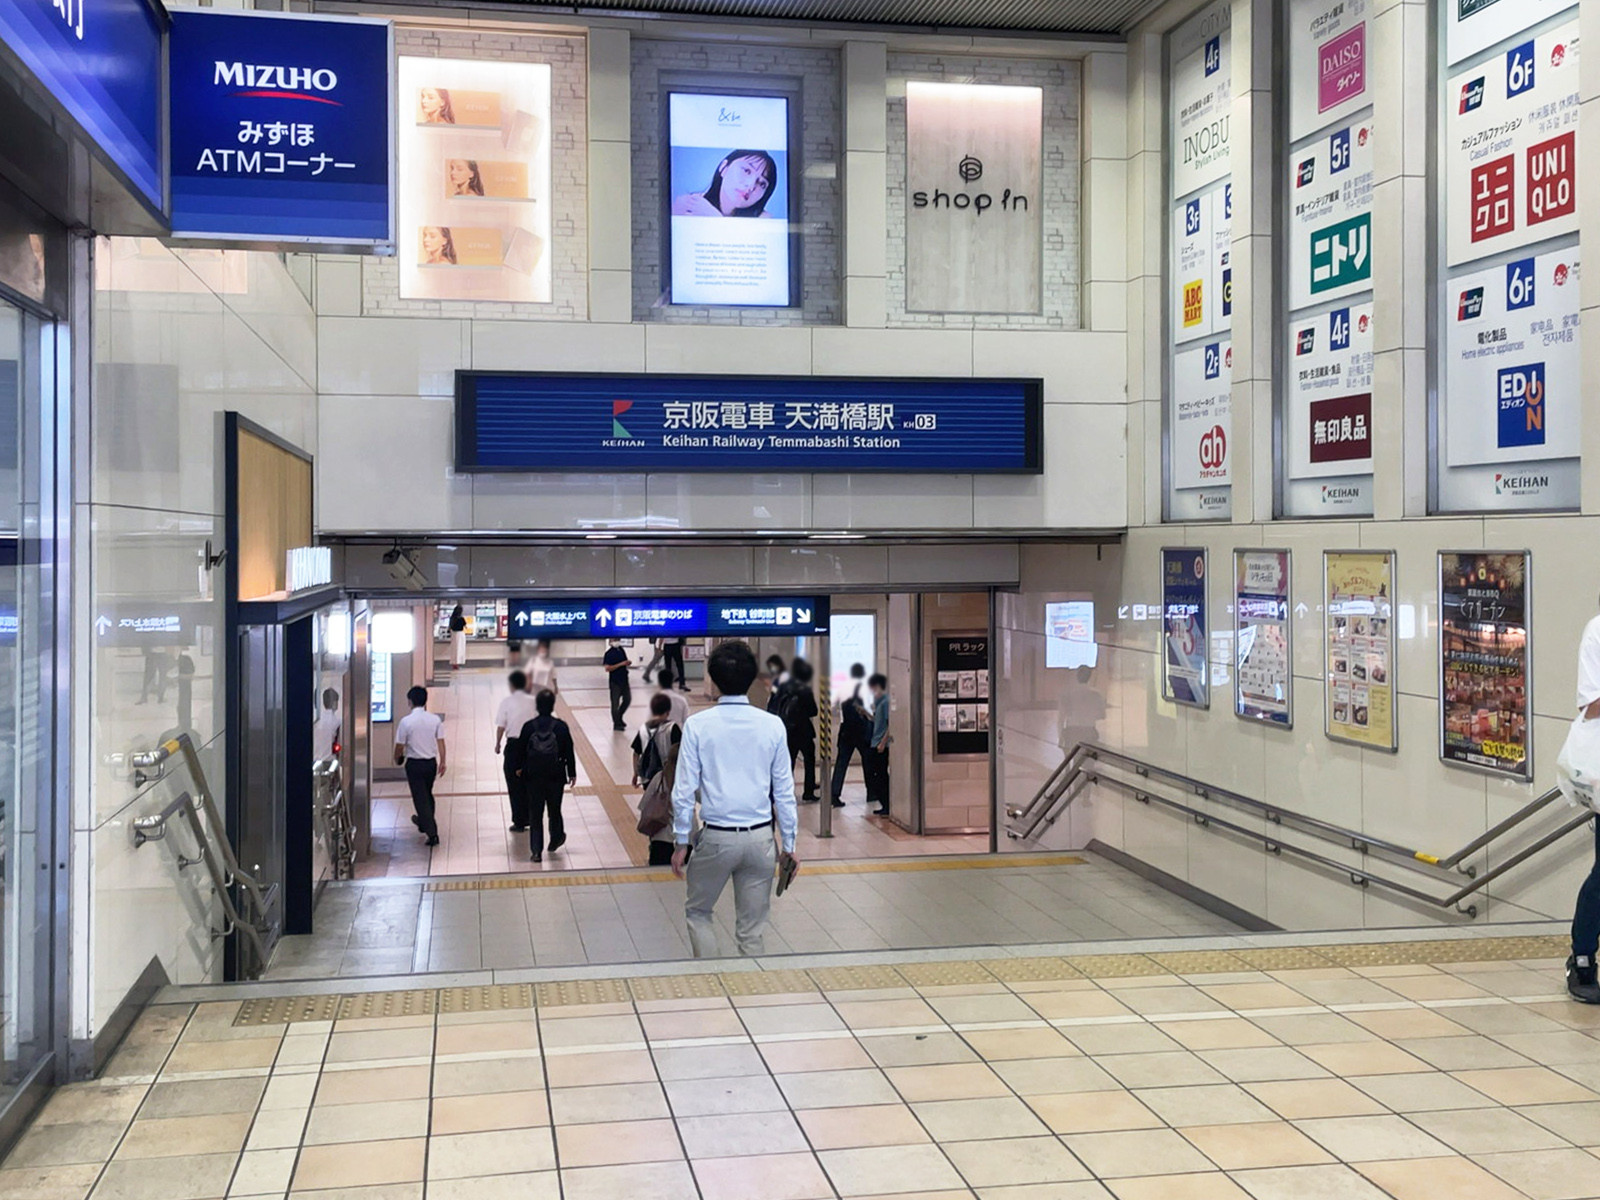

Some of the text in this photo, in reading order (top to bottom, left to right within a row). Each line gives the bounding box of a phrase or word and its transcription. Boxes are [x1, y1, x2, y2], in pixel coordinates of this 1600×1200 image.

[1205, 44, 1219, 70] 4F
[1322, 41, 1361, 75] DAISO
[214, 61, 338, 92] MIZUHO
[1336, 71, 1361, 92] ダイソー
[1509, 52, 1533, 91] 6F
[238, 121, 315, 147] みずほ
[1461, 118, 1522, 151] カジュアルファッション
[197, 148, 356, 176] ATMコーナー
[1332, 138, 1348, 169] 5F
[1532, 144, 1566, 181] UNI
[912, 189, 992, 216] shop
[1532, 178, 1570, 218] QLO
[1187, 205, 1199, 232] 3F
[1313, 224, 1367, 283] ニトリ
[1185, 285, 1202, 308] ABC
[1509, 267, 1533, 304] 6F
[1184, 306, 1202, 322] MART
[1331, 314, 1348, 345] 4F
[1477, 328, 1507, 344] 電化製品
[1206, 349, 1218, 375] 2F
[1462, 349, 1477, 360] Home
[662, 400, 895, 431] 京阪電車 天満橋駅
[1500, 398, 1526, 409] エディオン
[916, 415, 935, 429] 03
[1314, 414, 1367, 445] 無印良品
[602, 439, 645, 447] KEIHAN
[663, 434, 901, 450] Keihan Railway Temmabashi Station
[1327, 488, 1359, 498] KEIHAN
[1503, 476, 1549, 488] KEIHAN
[1203, 496, 1227, 505] KEIHAN
[1461, 598, 1506, 620] ビアガーデン
